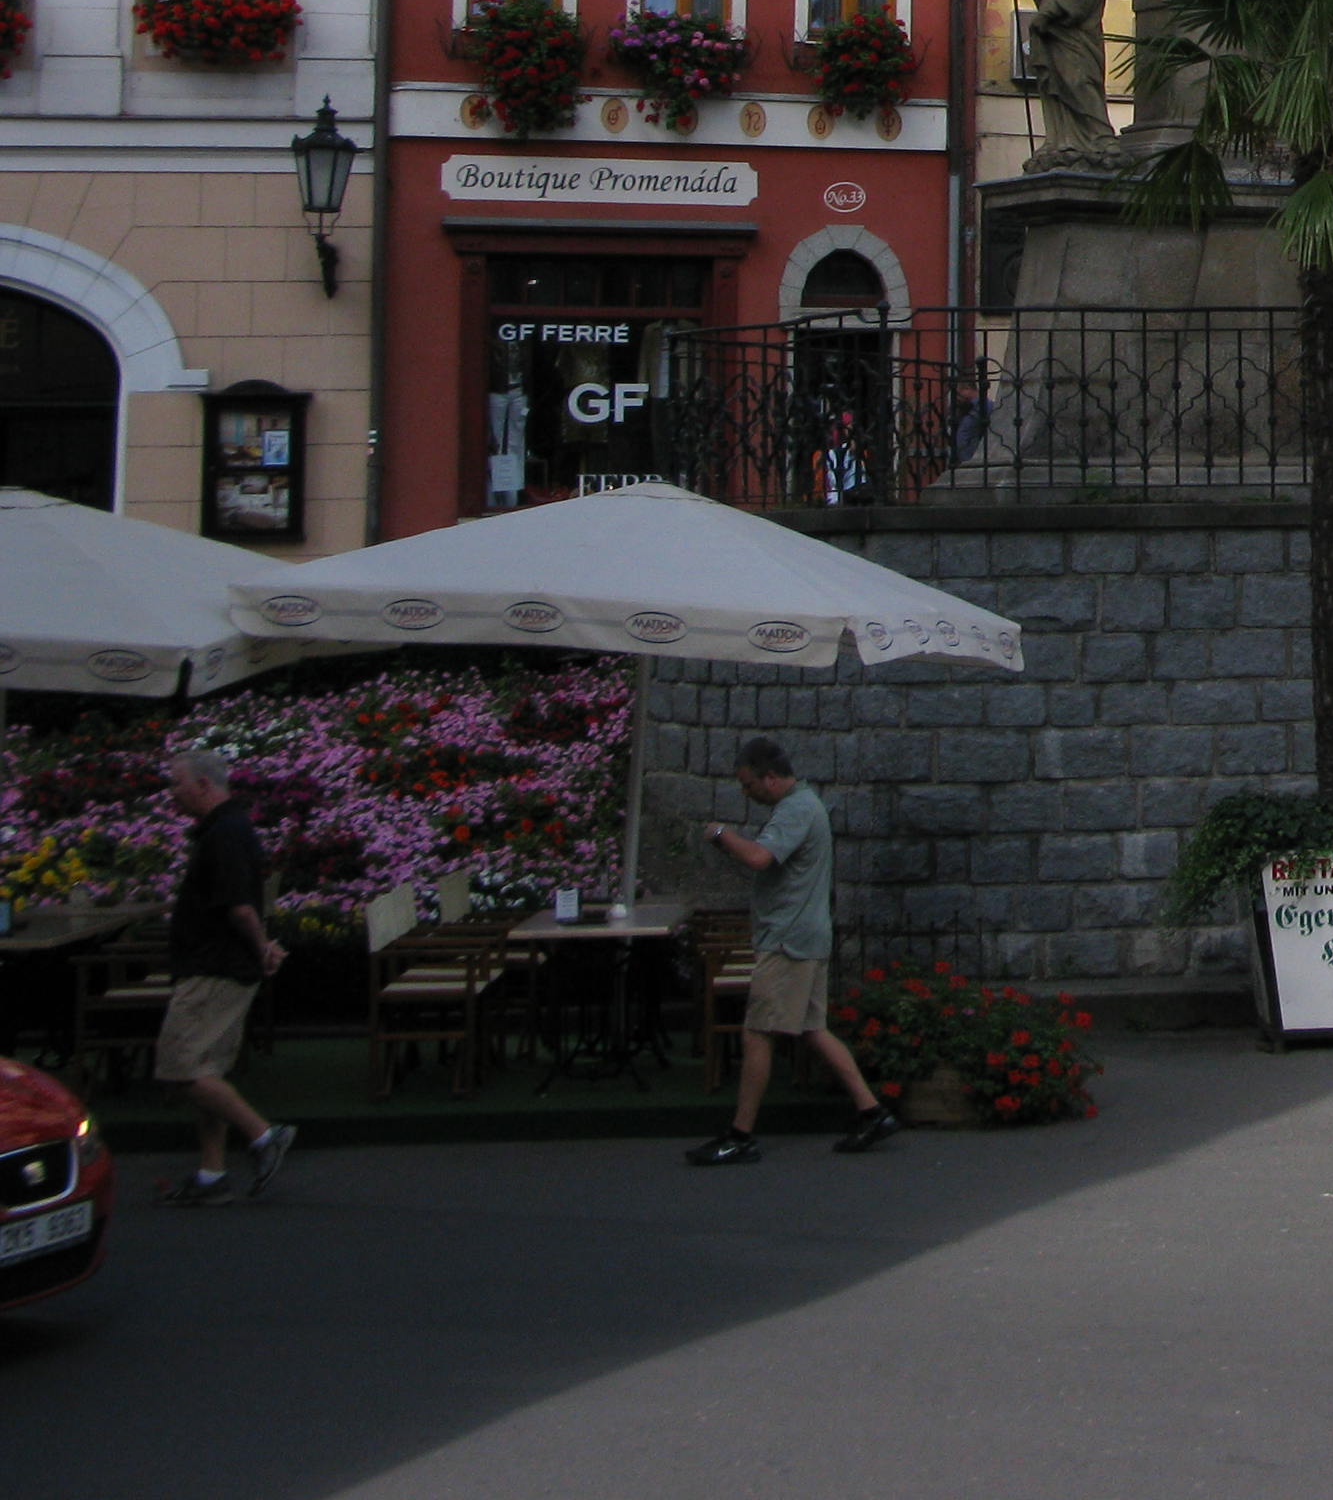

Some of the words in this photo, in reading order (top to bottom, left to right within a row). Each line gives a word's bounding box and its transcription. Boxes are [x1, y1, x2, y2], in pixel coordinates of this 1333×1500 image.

[456, 163, 580, 199] Boutique
[589, 165, 738, 194] Promenáda
[499, 323, 534, 341] GF
[541, 322, 629, 342] FERRÉ
[568, 383, 649, 422] GF
